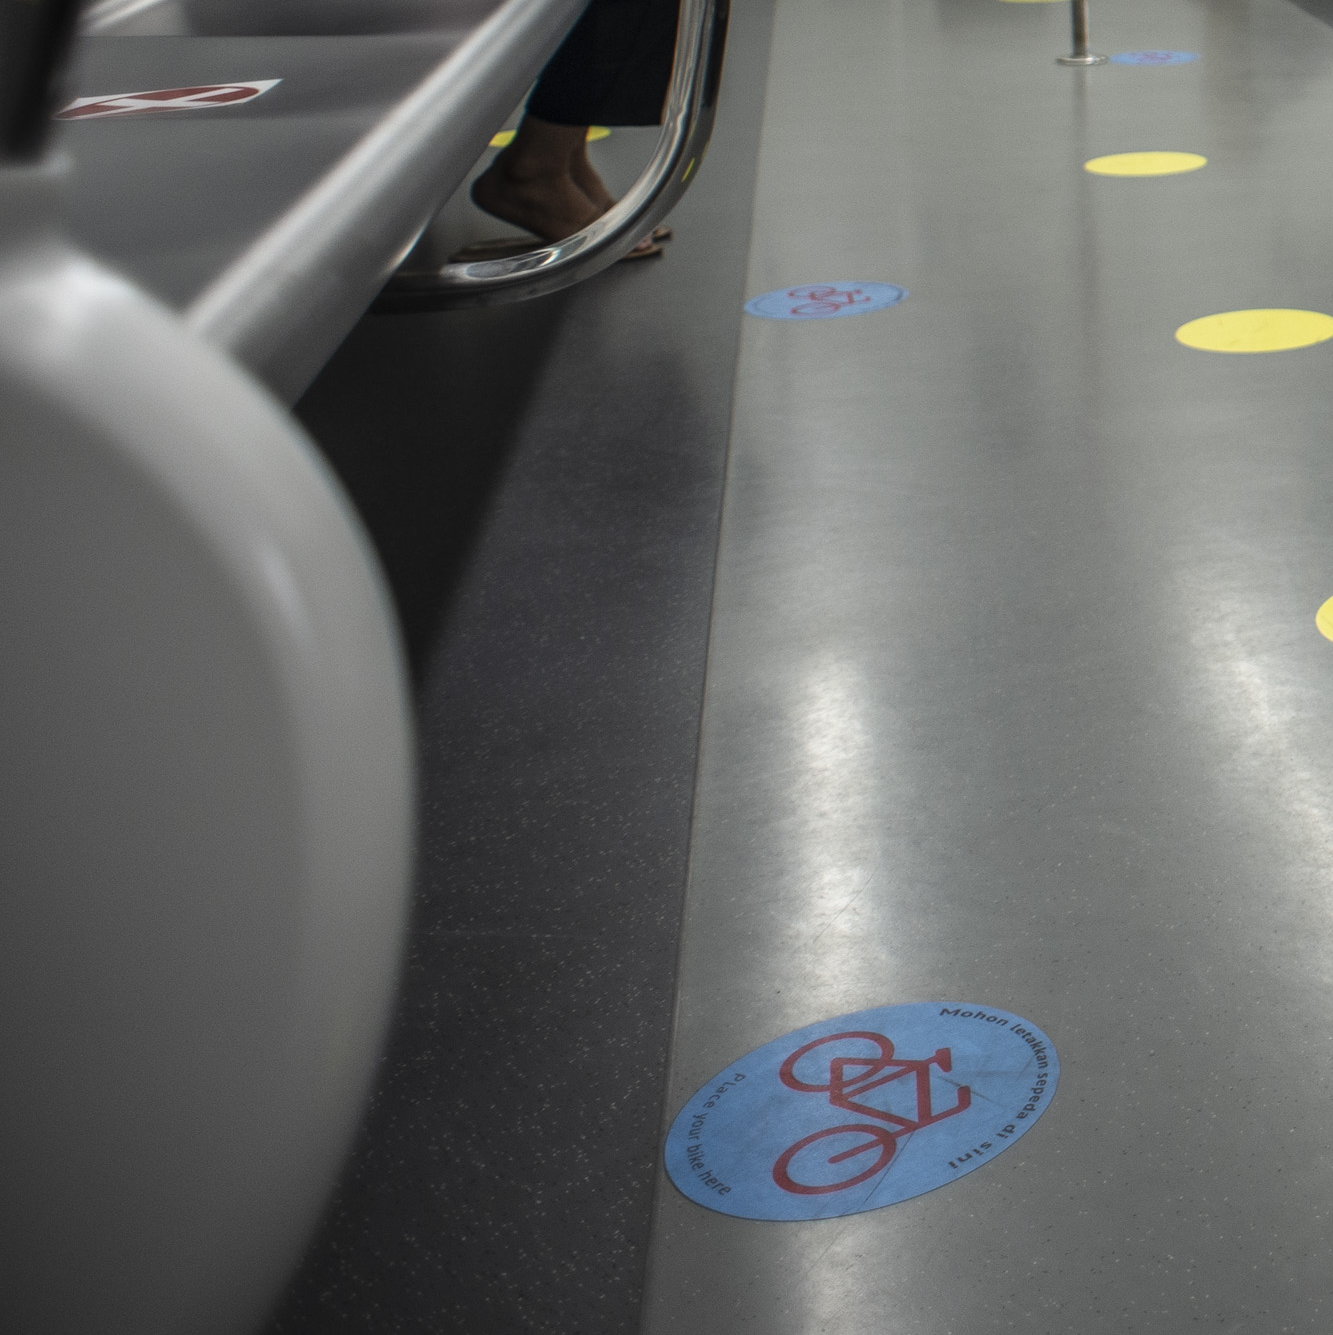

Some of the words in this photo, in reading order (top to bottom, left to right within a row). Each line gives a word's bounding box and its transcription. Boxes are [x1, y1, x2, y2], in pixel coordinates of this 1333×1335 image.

[939, 1008, 1009, 1026] Mohon
[1010, 1023, 1049, 1069] letakkan
[703, 1073, 746, 1108] Place
[1016, 1072, 1048, 1119] sepeda
[688, 1112, 708, 1140] your
[997, 1124, 1016, 1138] di
[686, 1144, 704, 1171] bike
[948, 1141, 992, 1169] sini
[698, 1169, 731, 1196] here
